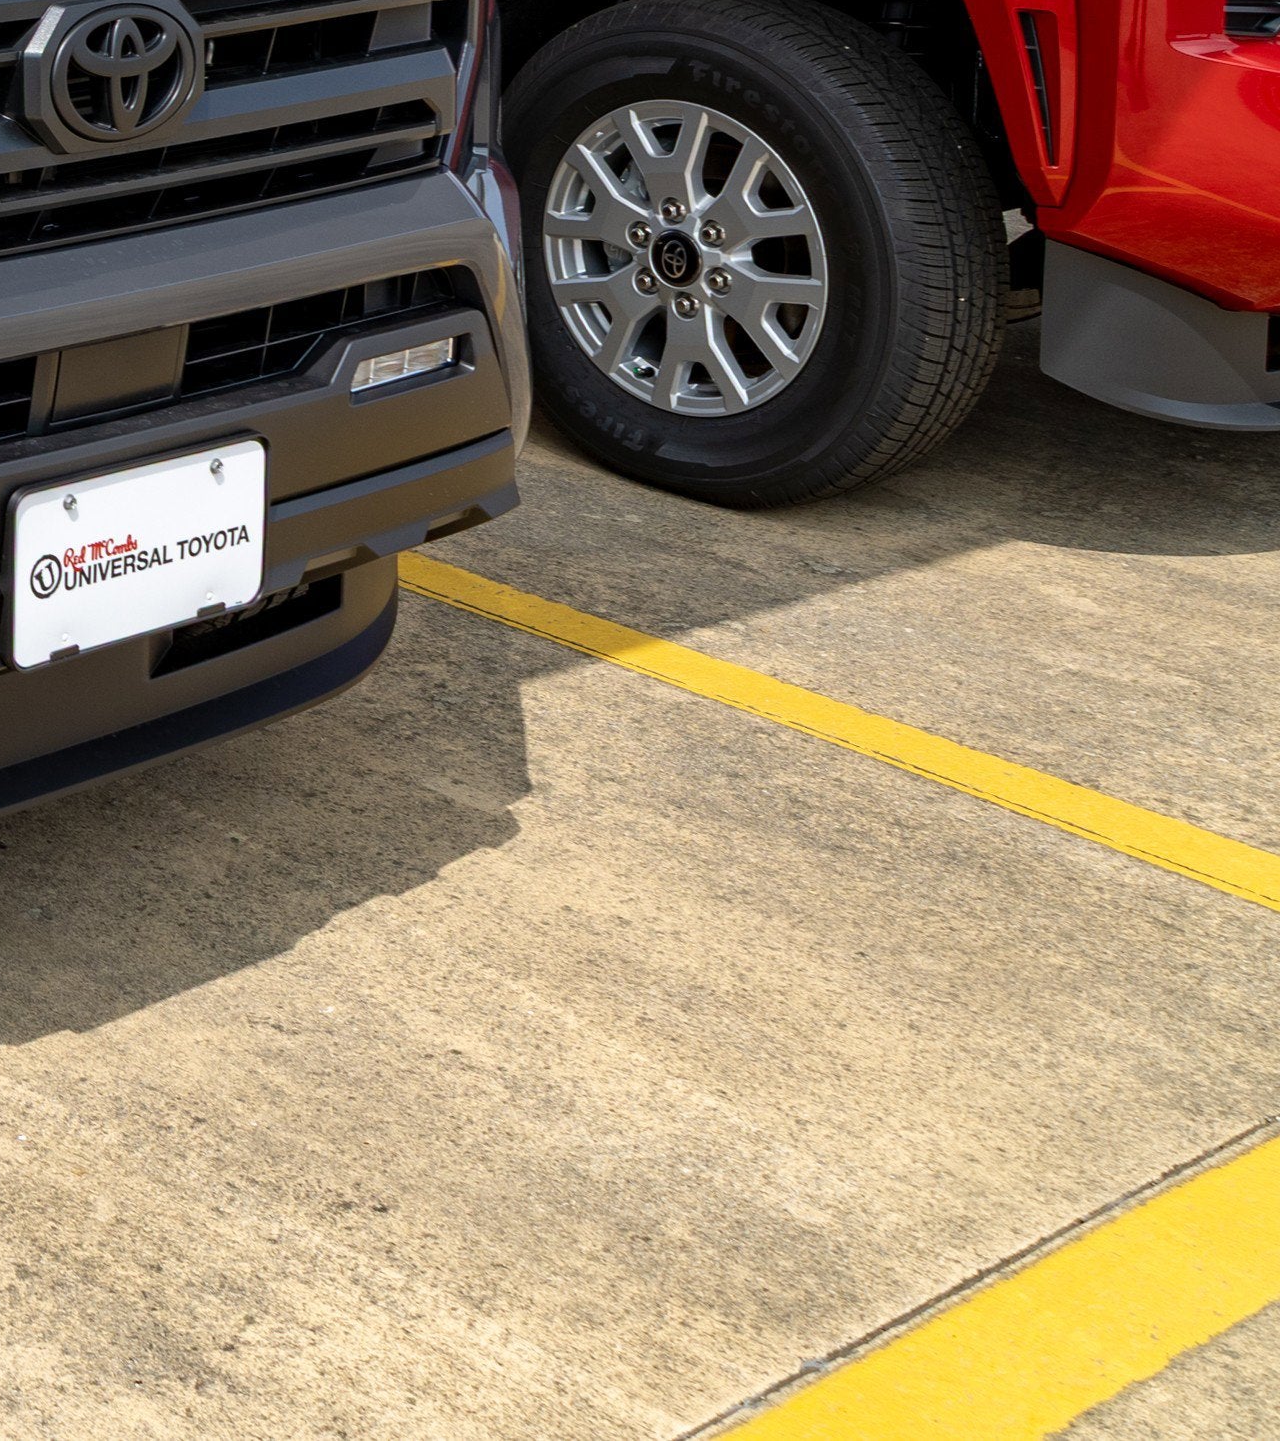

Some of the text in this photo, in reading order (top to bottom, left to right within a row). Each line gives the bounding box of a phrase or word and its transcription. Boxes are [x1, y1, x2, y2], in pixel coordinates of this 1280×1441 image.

[63, 534, 138, 570] Red McCombs
[64, 525, 250, 591] UNIVERSAL TOYOTA
